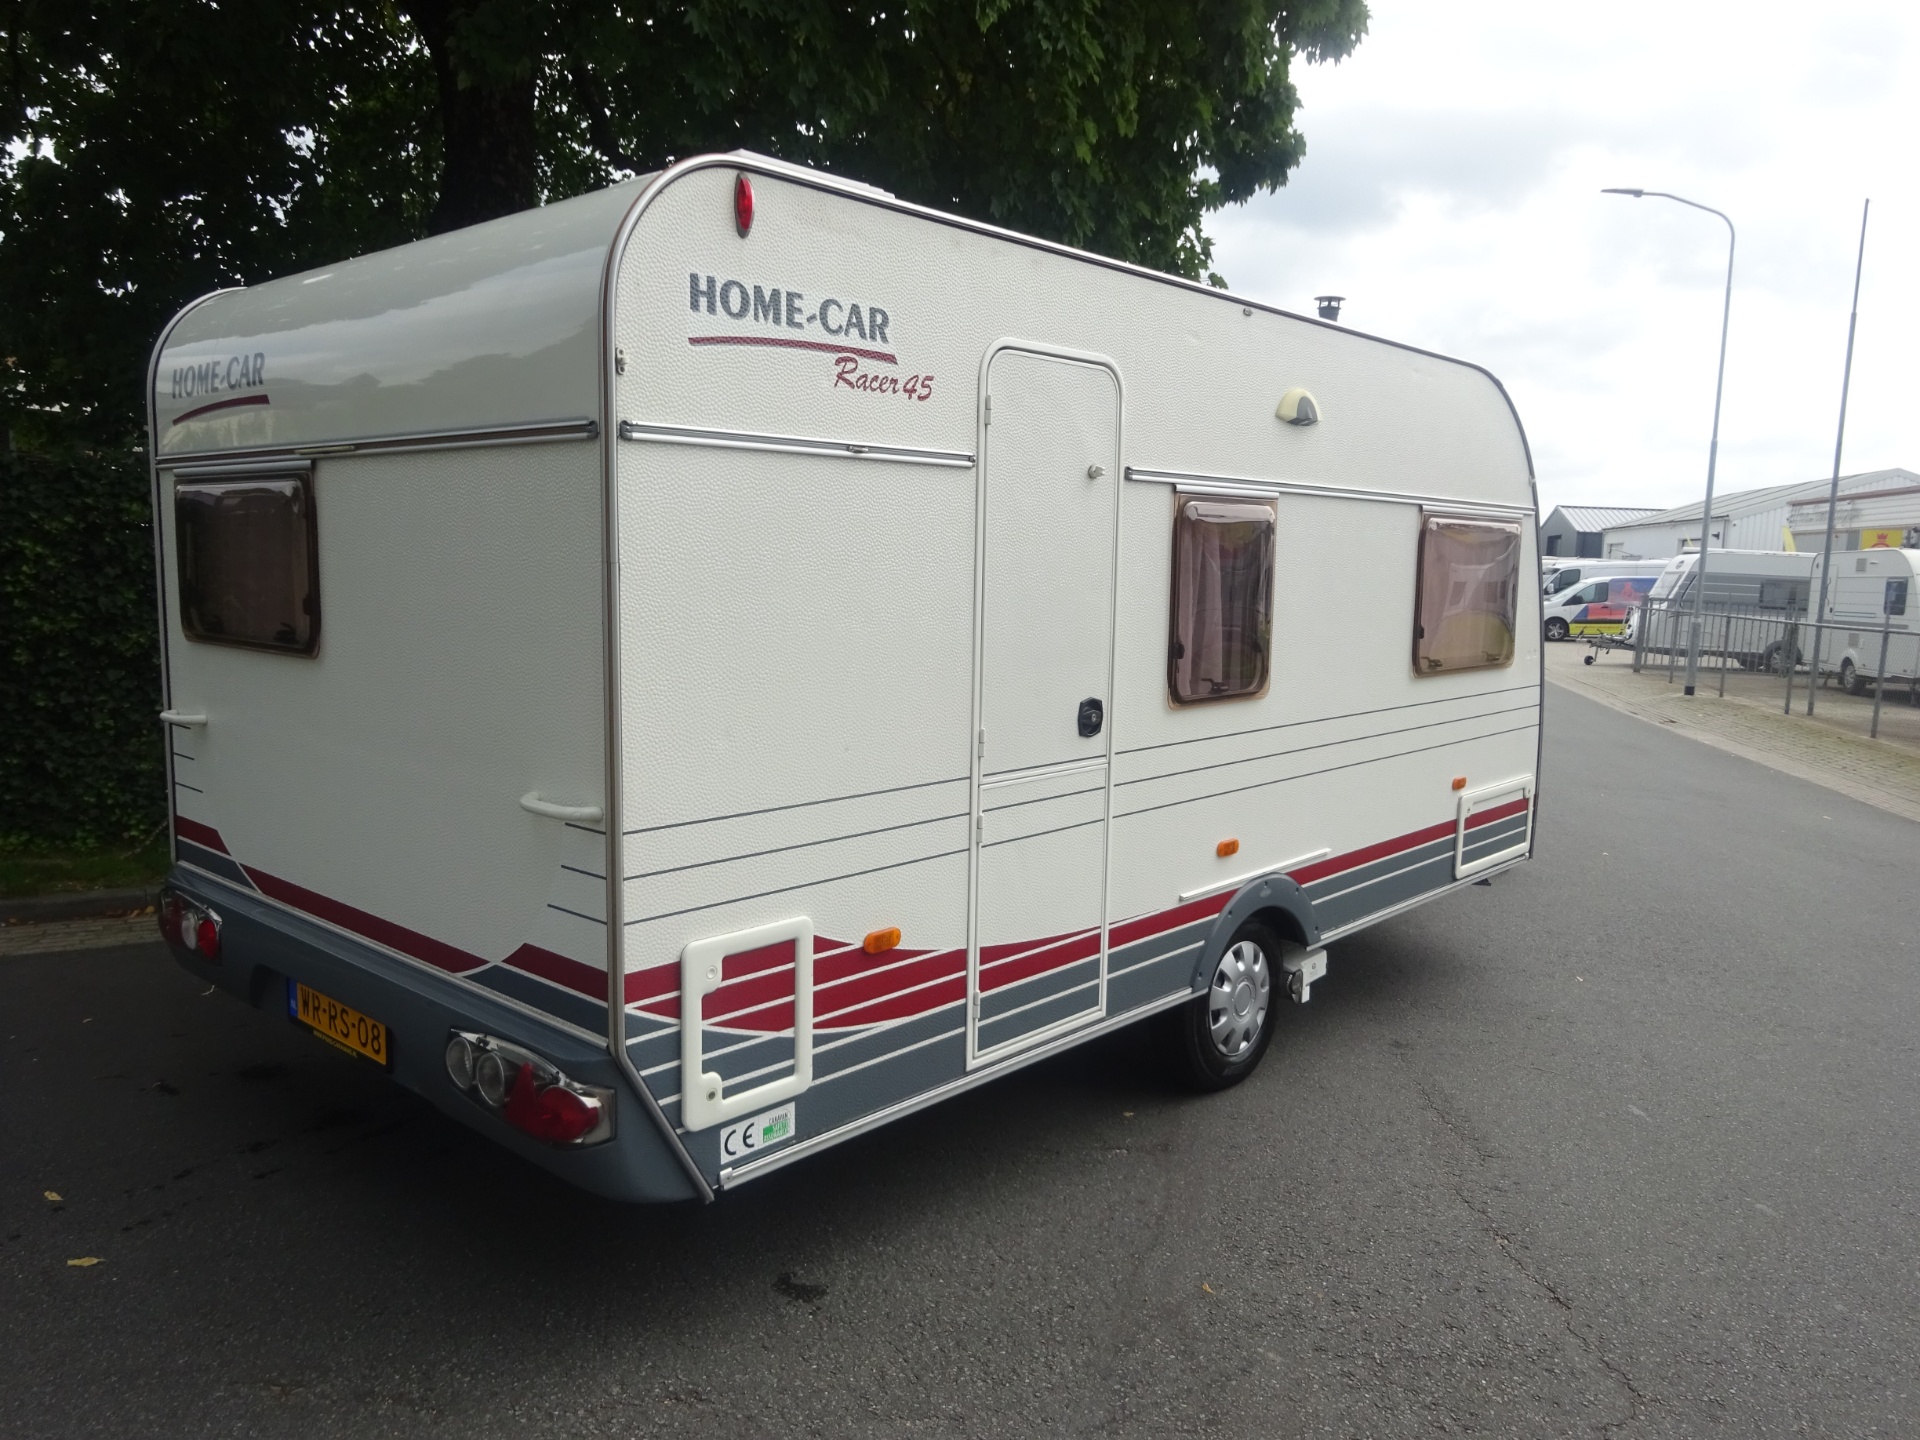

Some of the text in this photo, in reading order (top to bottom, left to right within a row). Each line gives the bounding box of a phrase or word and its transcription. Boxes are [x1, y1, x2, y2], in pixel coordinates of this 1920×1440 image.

[690, 273, 889, 344] HOME-CAR
[171, 352, 265, 399] HOME-CAR
[834, 356, 934, 401] Racer 45
[301, 986, 381, 1055] WR-RS-08
